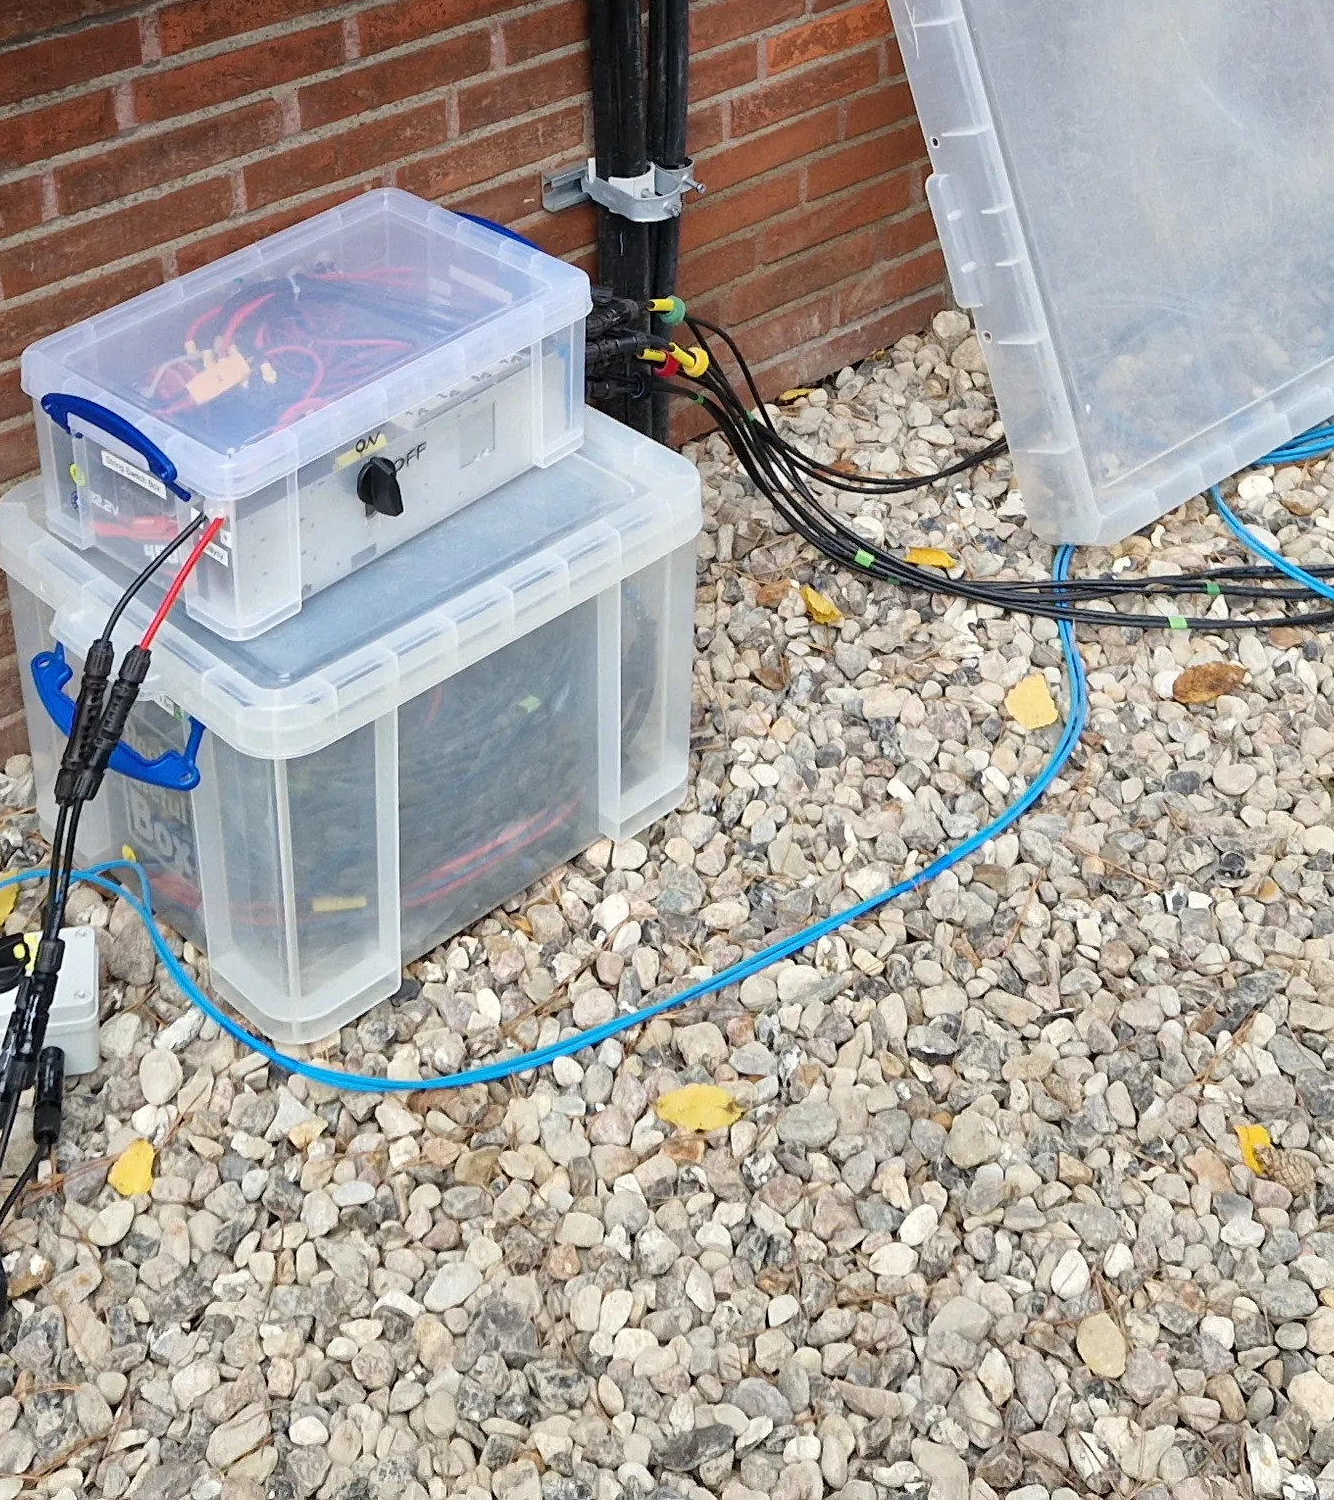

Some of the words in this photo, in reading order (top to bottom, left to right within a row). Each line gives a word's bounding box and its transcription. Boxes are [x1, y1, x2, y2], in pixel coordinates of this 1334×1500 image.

[355, 431, 381, 453] ON
[393, 441, 427, 472] OFF
[105, 455, 126, 475] String
[147, 477, 162, 493] Box
[130, 788, 194, 879] Box
